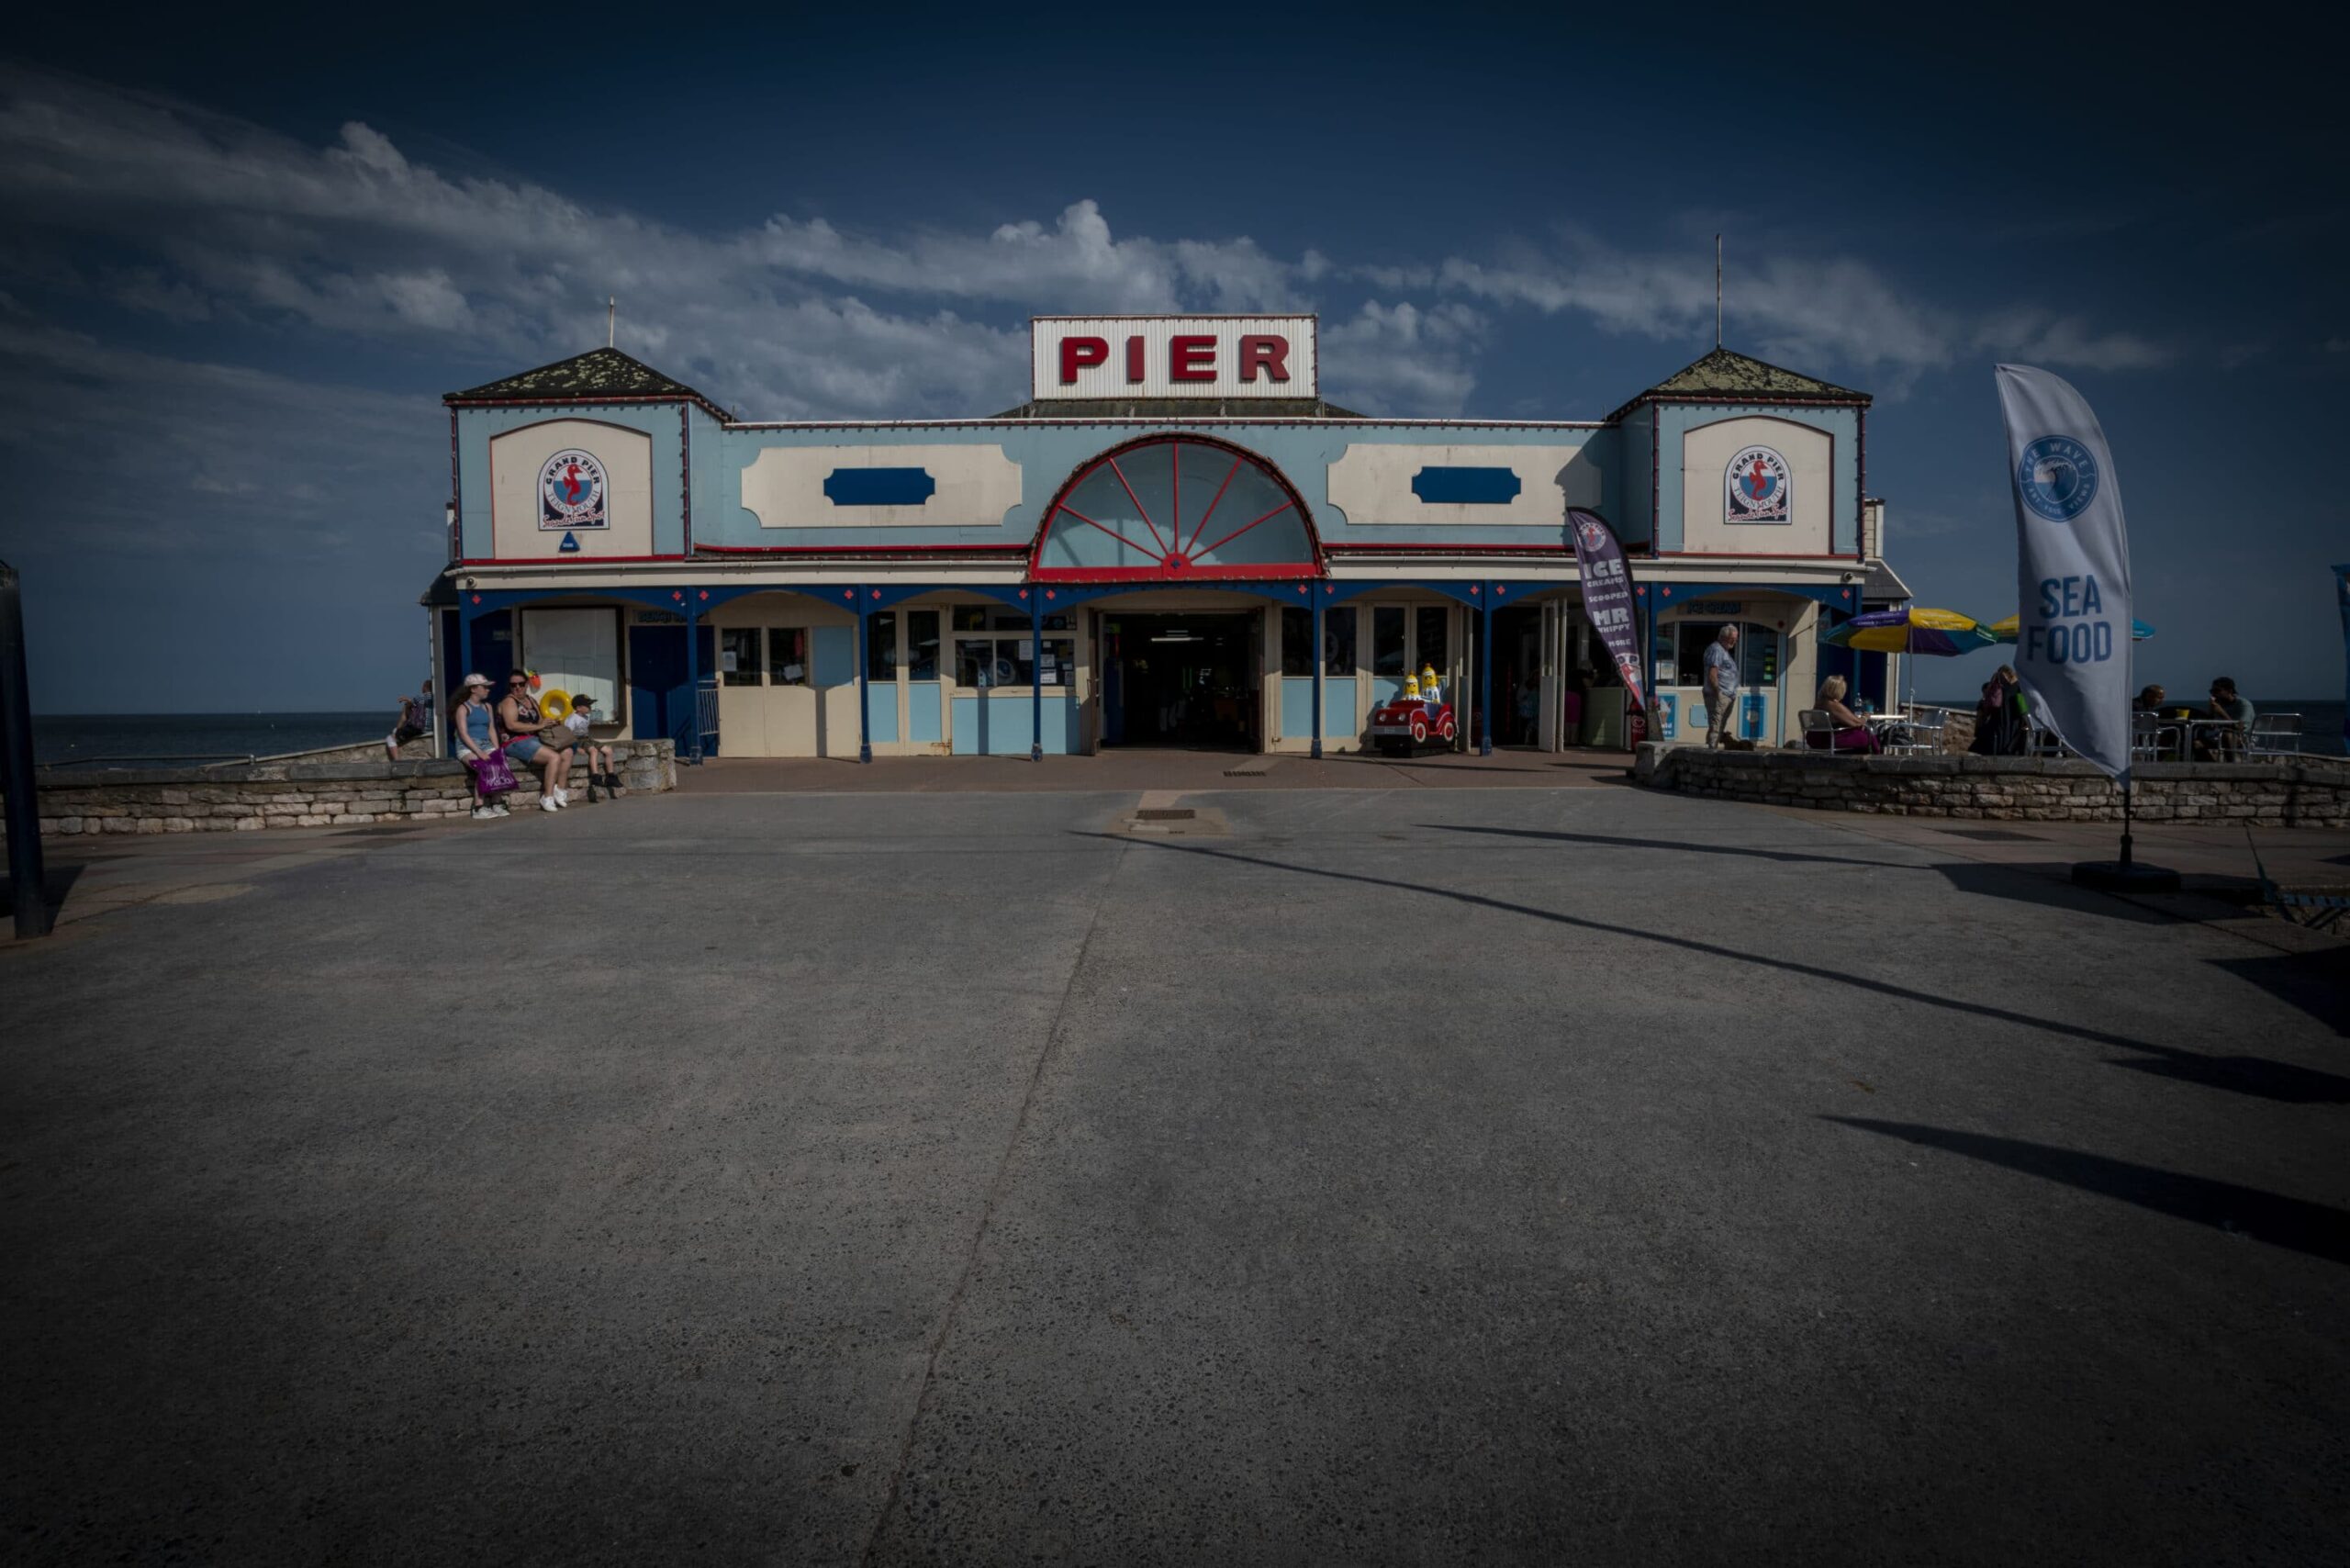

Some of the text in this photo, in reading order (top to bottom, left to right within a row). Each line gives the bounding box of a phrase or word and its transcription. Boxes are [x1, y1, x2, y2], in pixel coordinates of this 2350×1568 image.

[1060, 334, 1290, 384] PIER
[1732, 453, 1785, 481] GRAND PIER
[2024, 442, 2089, 472] THE WAVE
[545, 456, 600, 485] GRAND PIER
[547, 489, 599, 515] TEIGNMOUTH
[1733, 487, 1784, 509] TEIGNMOUTH
[1583, 558, 1624, 580] ICE
[1586, 577, 1624, 588] CREAMS
[1588, 591, 1628, 603] SCOOPED
[1687, 601, 1741, 613] ICE CREAM
[2039, 574, 2101, 620] SEA
[1593, 607, 1630, 626] MR
[1599, 623, 1630, 633] WHIPPY
[1608, 638, 1631, 647] MORE
[2026, 621, 2112, 665] FOOD
